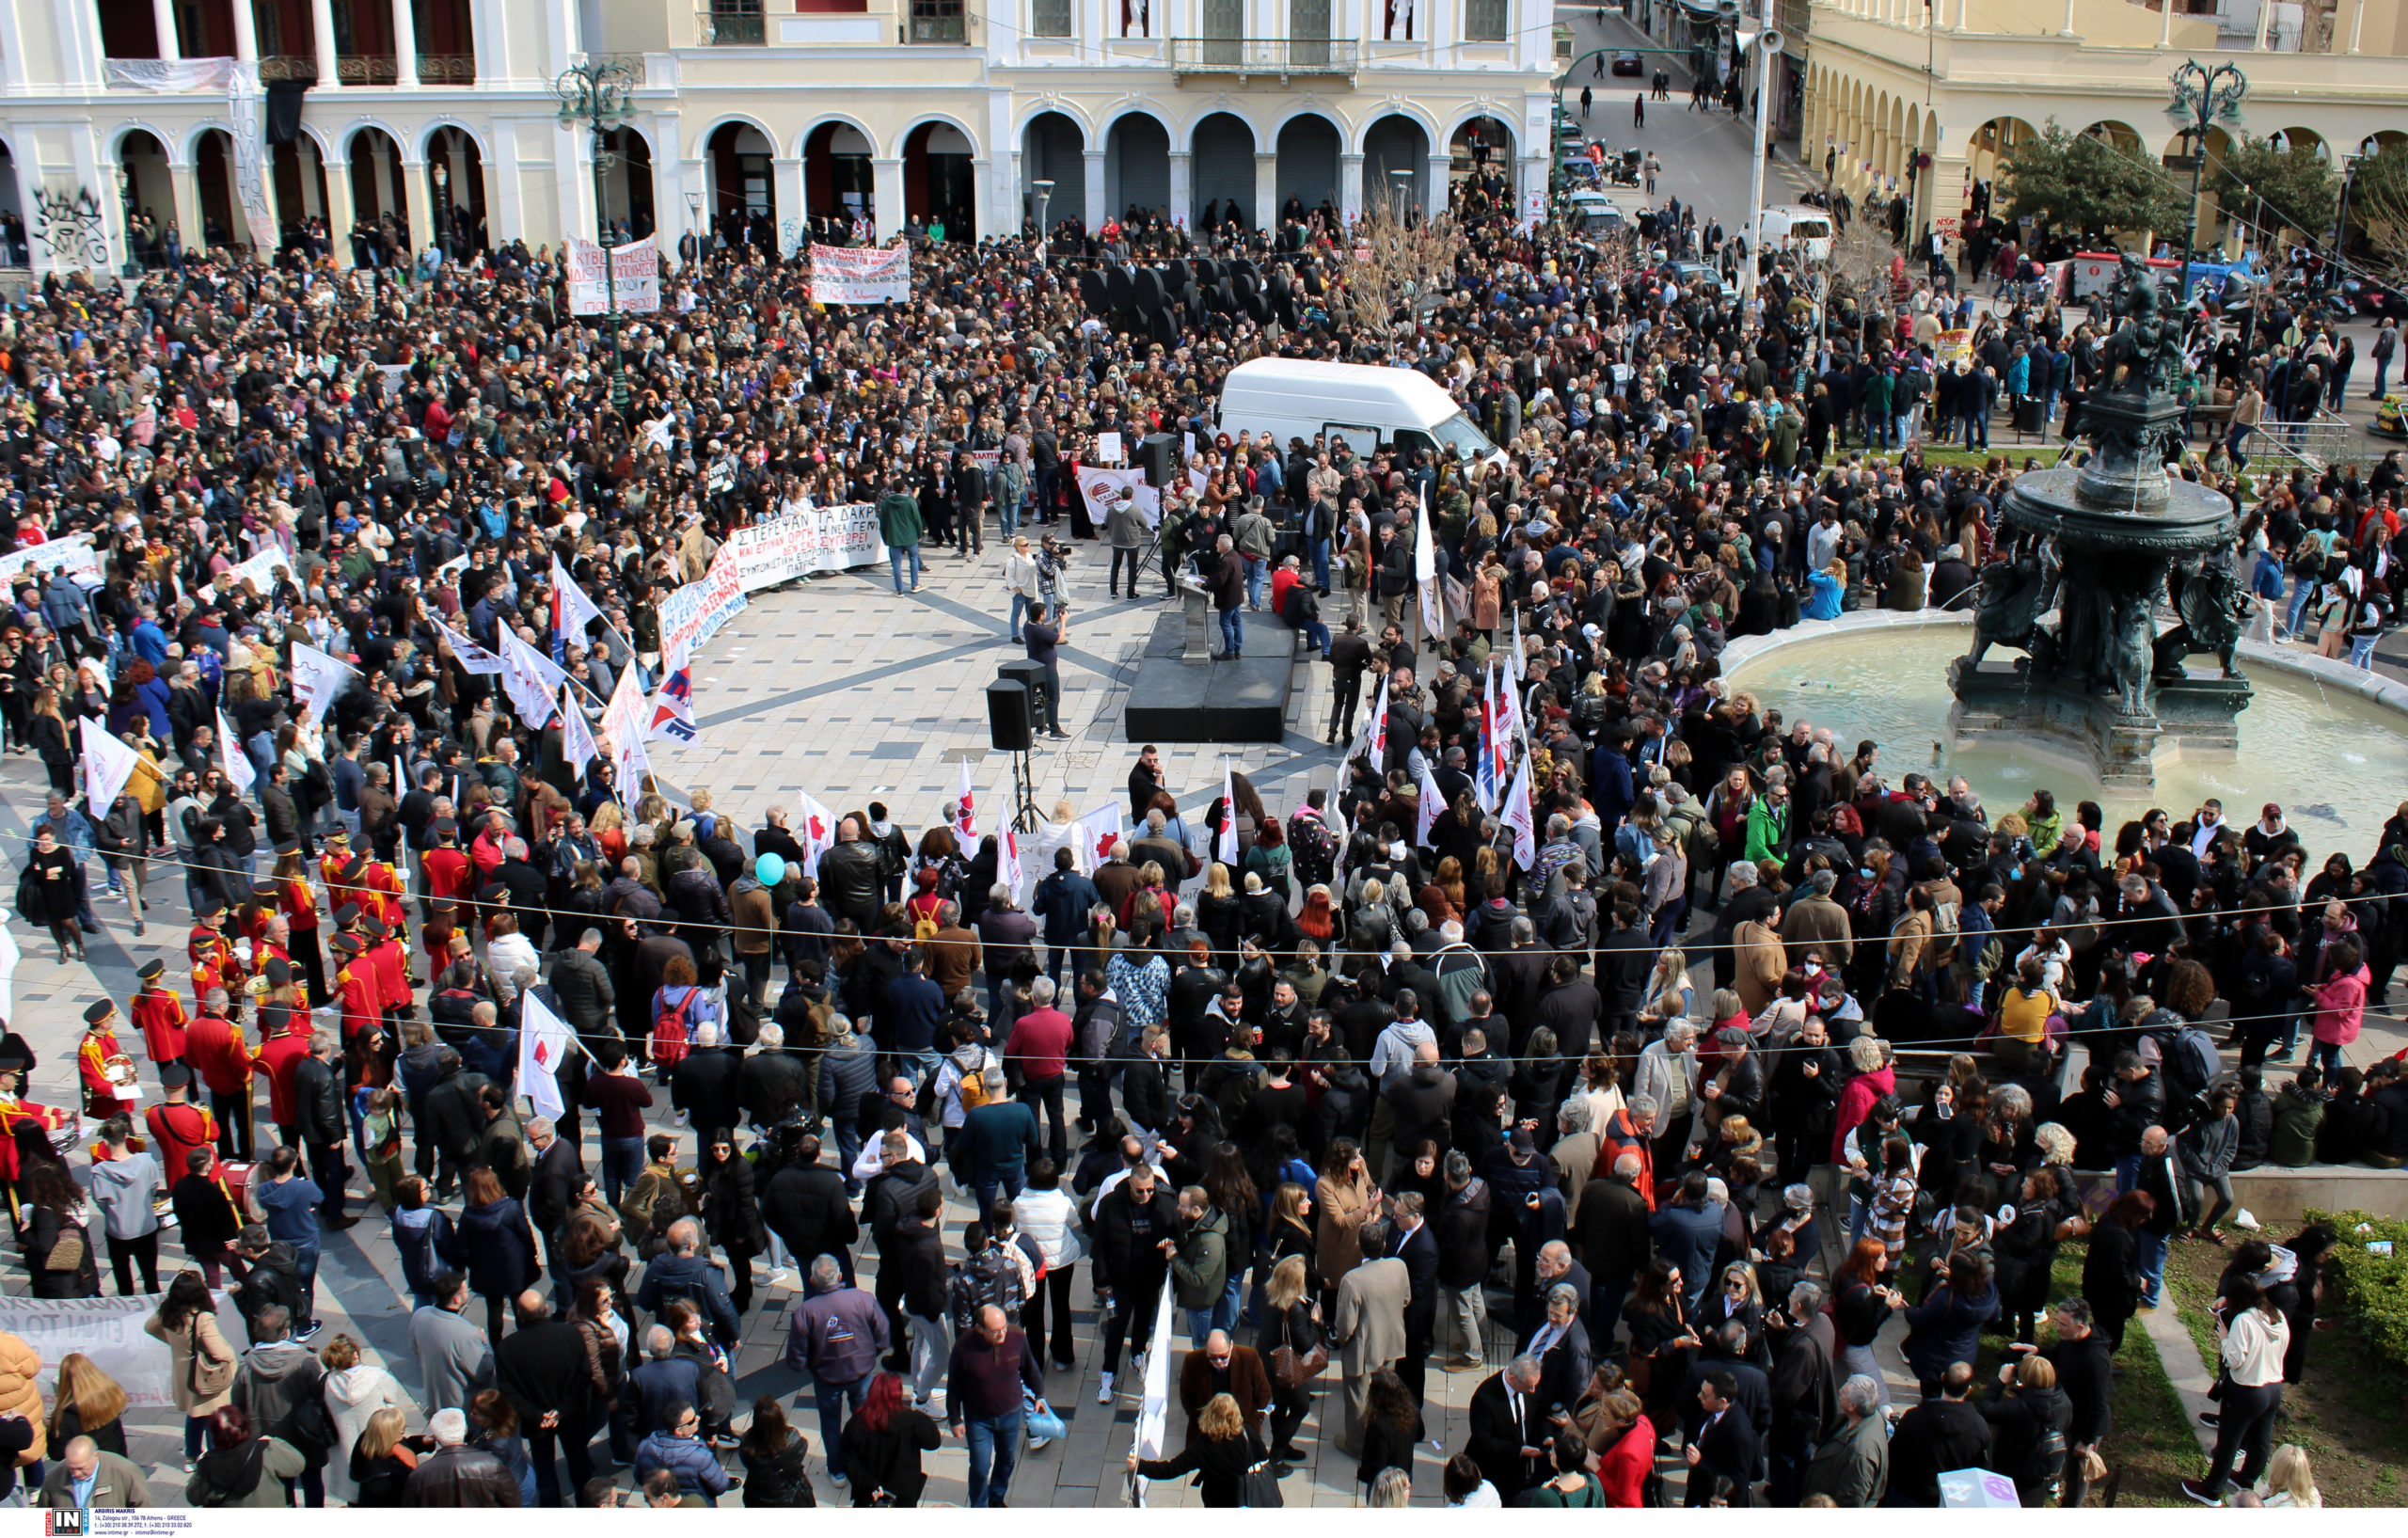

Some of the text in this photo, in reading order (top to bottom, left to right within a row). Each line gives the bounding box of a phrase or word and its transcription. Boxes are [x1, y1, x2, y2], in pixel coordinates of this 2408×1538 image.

[576, 246, 656, 264] ΚΥΒΕΝΗΣΕΙΣ
[737, 506, 876, 546] ΣΤΕΡΕΨΑΝ ΤΑ ΔΑΚΡ
[738, 547, 752, 558] ΚΑΙ
[755, 536, 784, 554] ΕΓΙΝΑΝ
[787, 527, 814, 543] ΟΡΓΗ
[818, 525, 828, 535] Η
[831, 523, 847, 534] ΝΕΑ
[783, 531, 868, 557] ΔΕΝ ΣΑΣ ΣΥΓΧΩΡΕΙ
[797, 547, 835, 562] ΕΠΙΤΡΟΠΗ
[786, 557, 816, 576] ΠΑΤΡΑΣ
